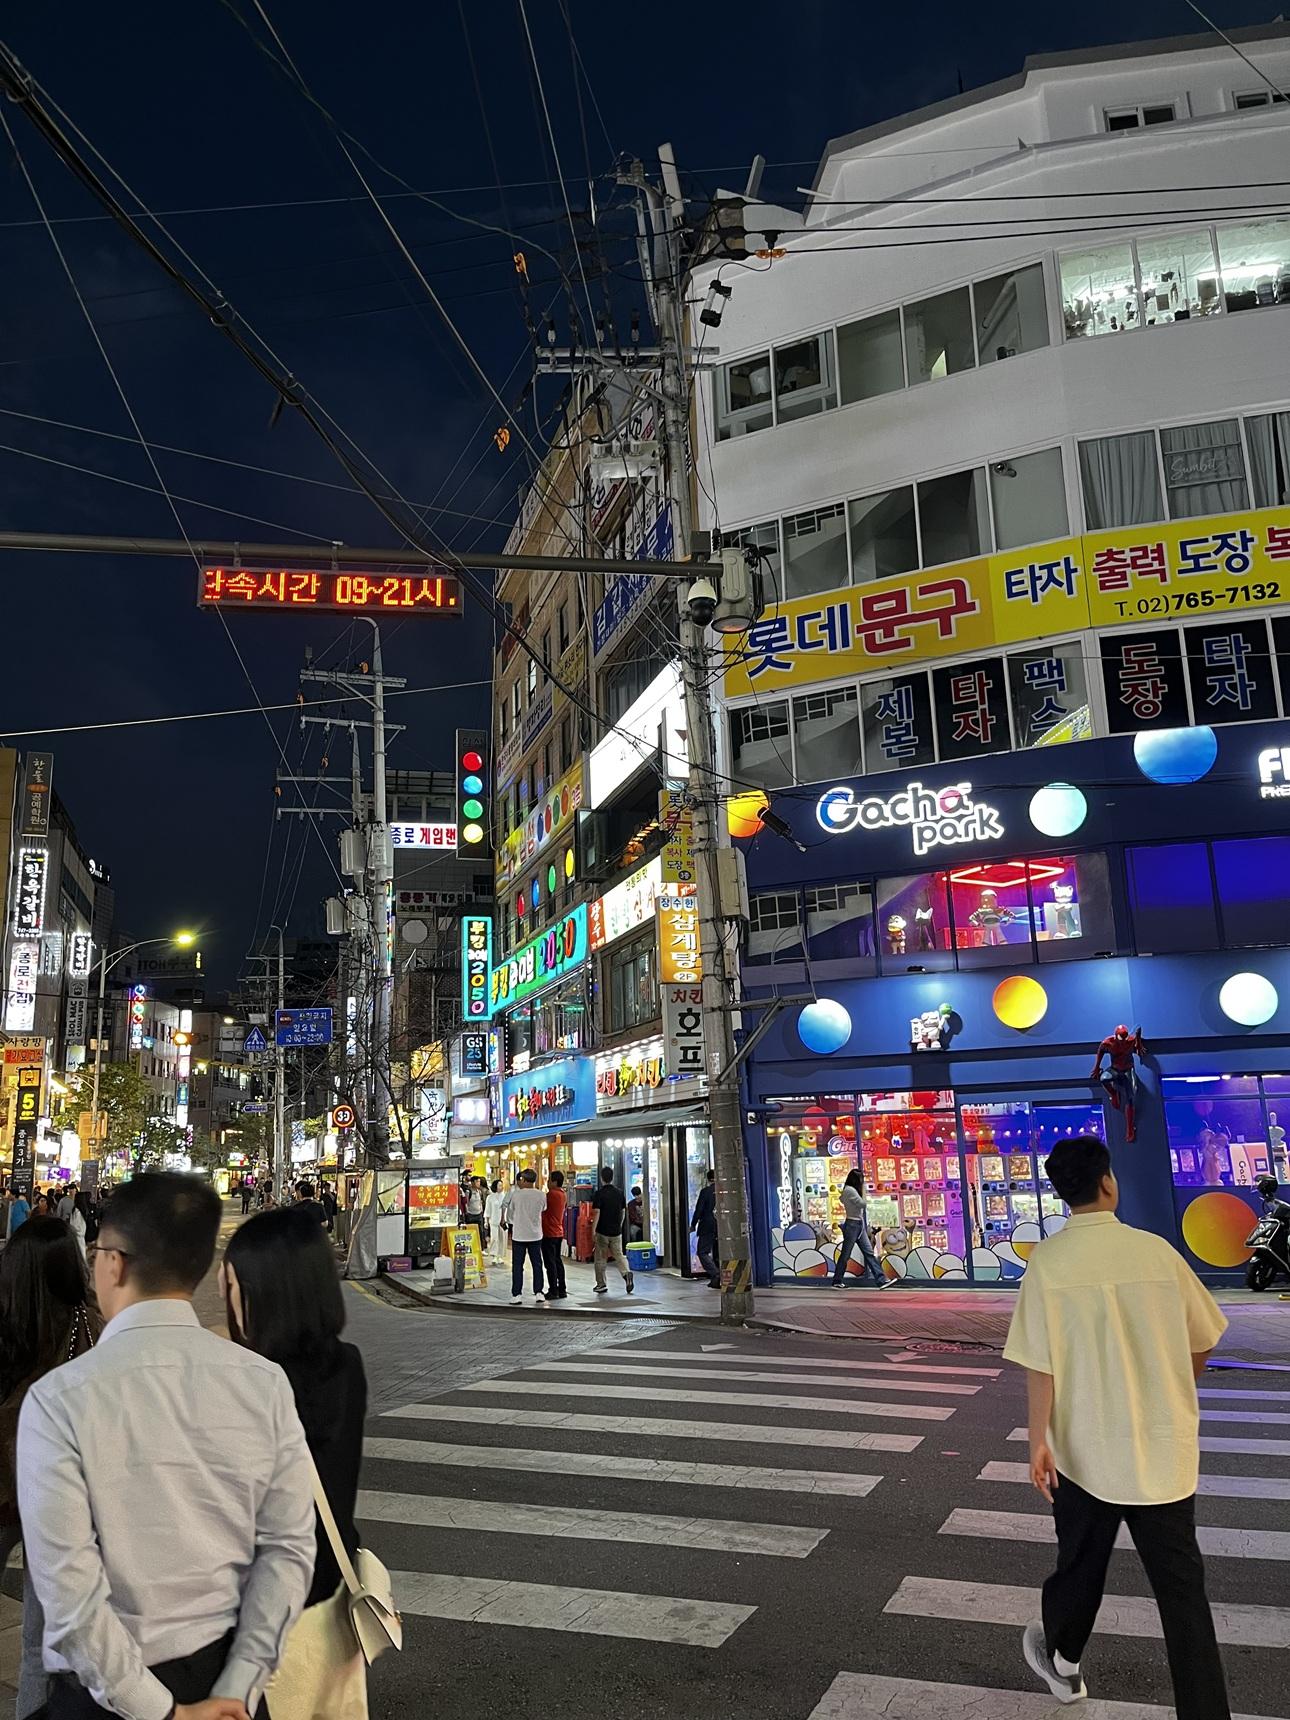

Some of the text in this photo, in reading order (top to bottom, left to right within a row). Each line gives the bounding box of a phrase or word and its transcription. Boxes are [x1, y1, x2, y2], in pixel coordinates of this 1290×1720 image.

[1004, 556, 1080, 605] 타자
[1092, 541, 1171, 594] 출력
[1176, 528, 1258, 577] 도장
[1024, 657, 1068, 733] 팩스
[1118, 642, 1169, 720] 도장
[1202, 633, 1256, 711] 타자
[875, 684, 916, 760] 제본
[950, 670, 997, 744] 타자
[817, 783, 973, 834] Gacha
[912, 803, 1005, 855] park
[391, 827, 415, 844] 종로
[667, 861, 683, 871] 도장
[22, 862, 42, 928] 한옥갈비
[538, 917, 576, 977] 2050
[669, 913, 700, 969] 삼계탕
[471, 961, 485, 1014] 2050
[678, 972, 693, 981] 2F
[8, 1036, 42, 1048] 사랑방
[466, 1036, 483, 1048] GS
[466, 1048, 482, 1059] 25
[675, 1007, 705, 1073] 호프
[22, 1093, 35, 1110] 5
[337, 1111, 350, 1122] 30
[15, 1129, 27, 1167] 종로3가
